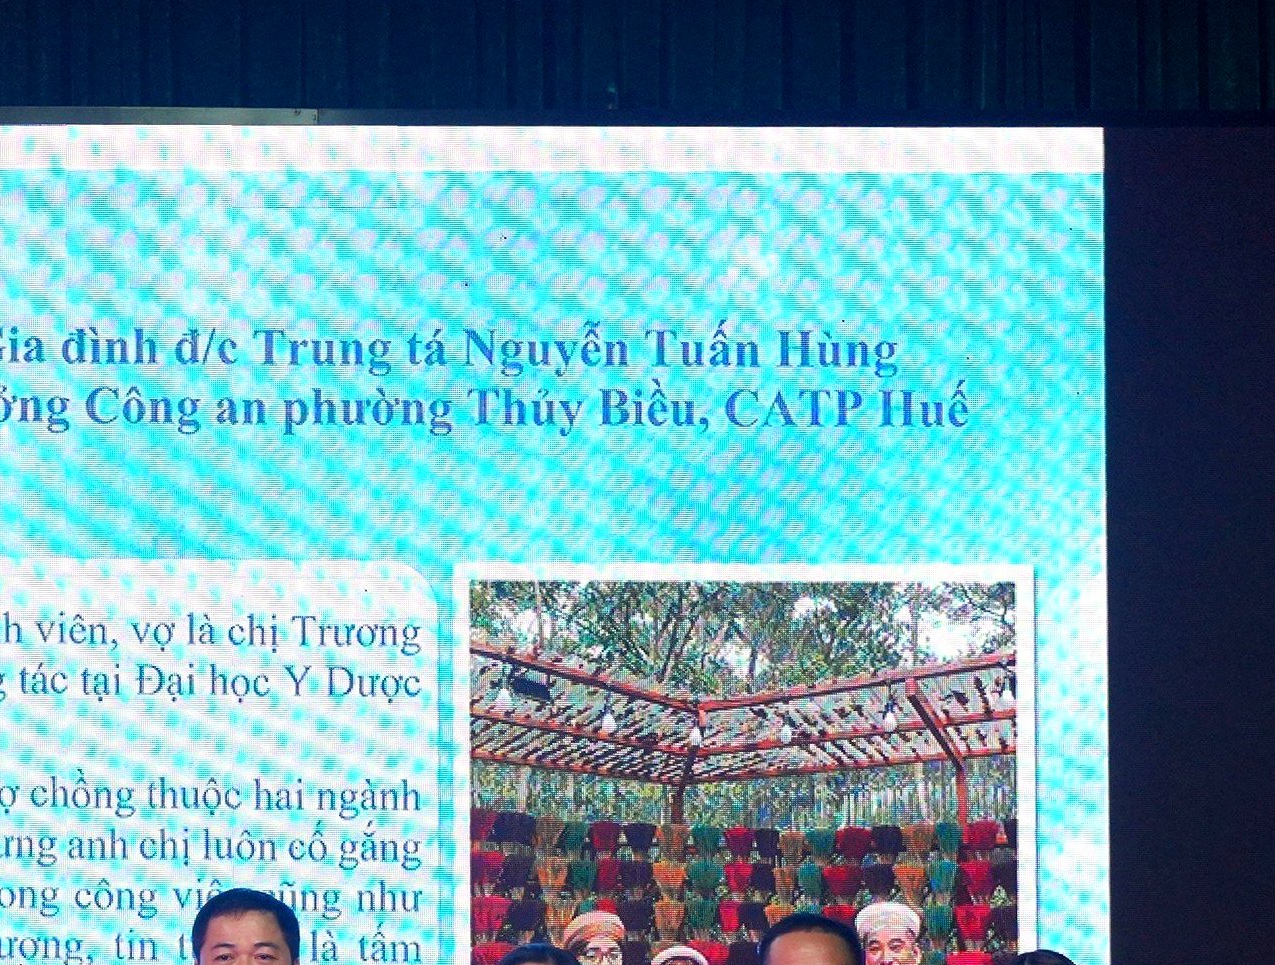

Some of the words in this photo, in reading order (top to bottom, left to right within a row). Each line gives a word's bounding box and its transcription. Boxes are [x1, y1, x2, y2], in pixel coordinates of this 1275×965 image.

[61, 327, 158, 366] đình
[174, 327, 238, 366] đ/c
[252, 328, 392, 377] Trung
[407, 328, 445, 368] tá
[463, 320, 630, 377] Nguyễn
[645, 319, 761, 368] Tuấn
[776, 328, 898, 378] Hùng
[84, 386, 201, 435] Công
[215, 398, 267, 426] an
[283, 387, 453, 436] phường
[468, 387, 584, 436] Thủy
[725, 388, 863, 428] CATP
[879, 379, 970, 428] Huế
[35, 612, 119, 650] viên,
[131, 619, 177, 653] vợ
[187, 611, 216, 646] là
[228, 613, 279, 654] chị
[291, 614, 422, 656] Trương
[20, 662, 69, 696] tác
[81, 664, 122, 702] tại
[135, 664, 196, 702] Đại
[209, 664, 271, 703] học
[284, 665, 313, 697] Y
[327, 665, 423, 704] Dược
[30, 768, 137, 819] chồng
[147, 777, 243, 815] thuộc
[253, 778, 305, 811] hai
[316, 779, 422, 820] ngành
[67, 828, 129, 862] anh
[139, 829, 190, 867] chị
[202, 829, 278, 862] luôn
[288, 819, 328, 862] cố
[338, 820, 423, 871] gắng
[74, 878, 157, 919] công
[267, 880, 343, 920] ũng
[357, 878, 423, 913] như
[115, 930, 157, 962] tin
[310, 929, 339, 962] là
[359, 922, 423, 963] tấm
